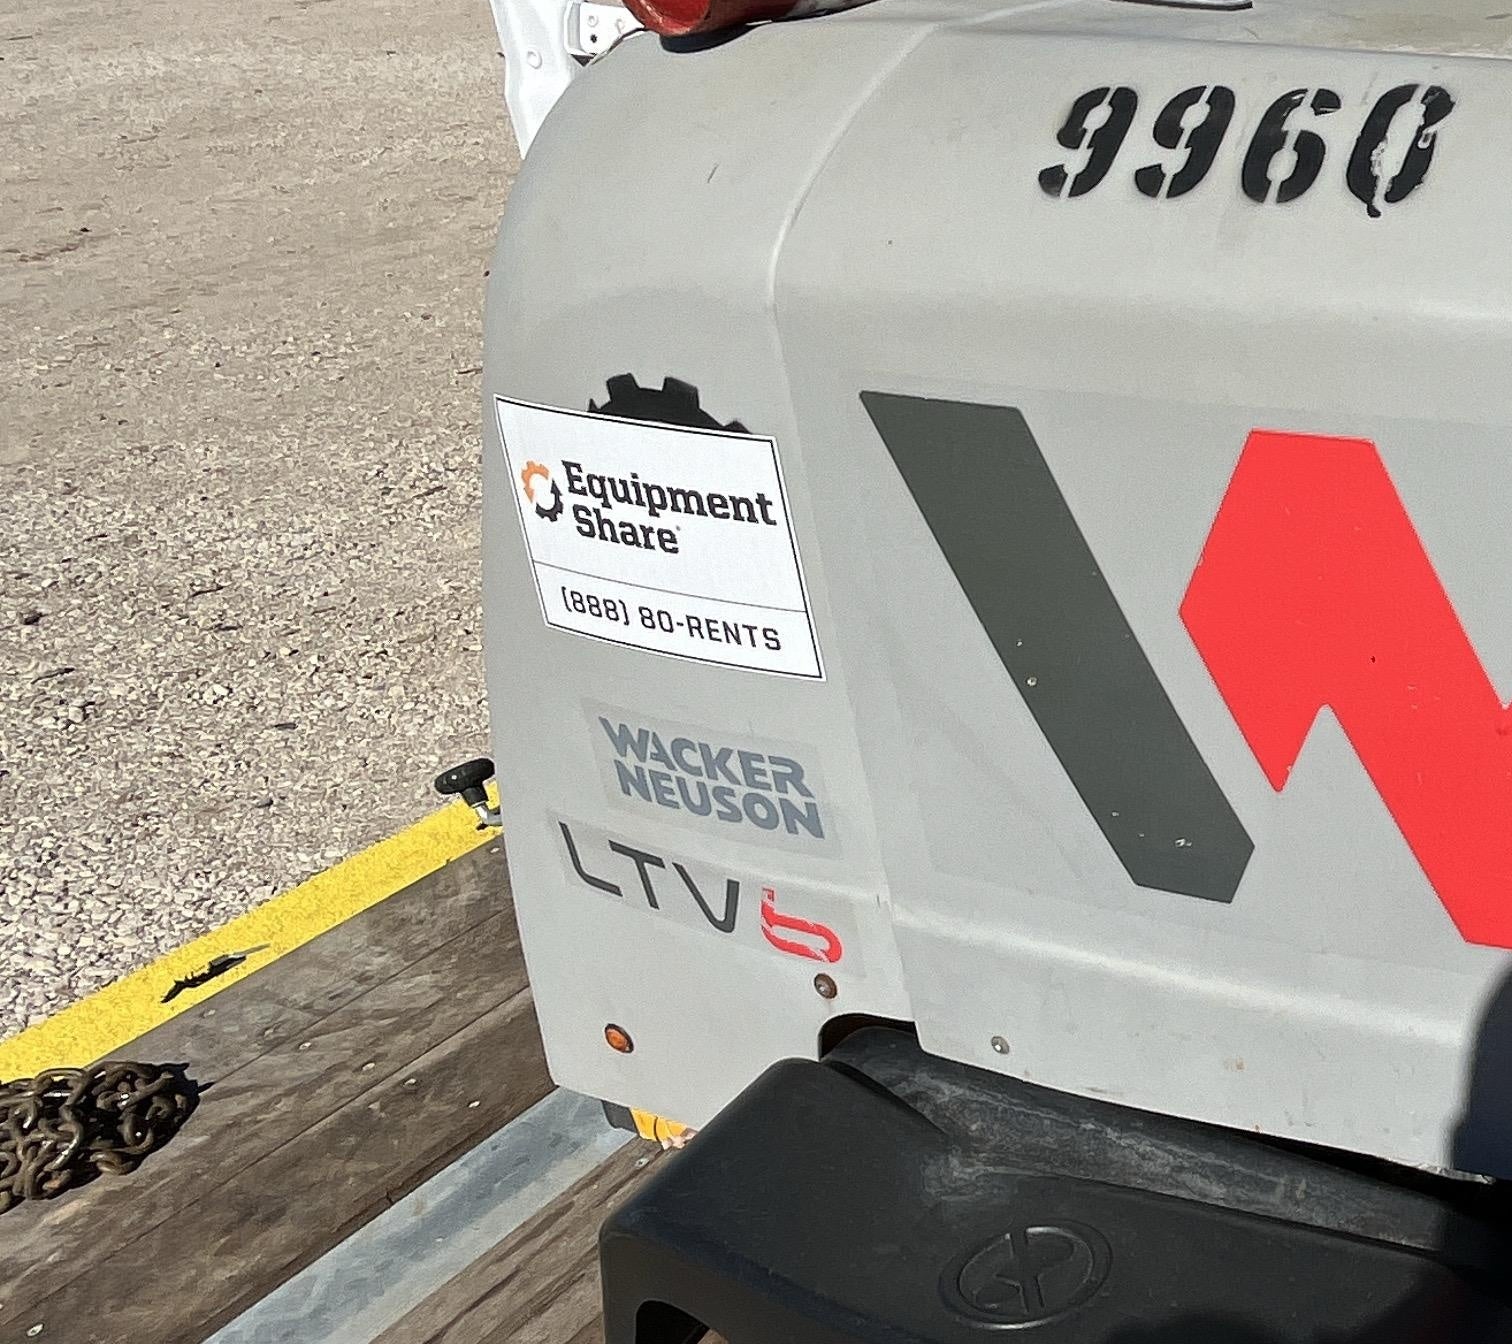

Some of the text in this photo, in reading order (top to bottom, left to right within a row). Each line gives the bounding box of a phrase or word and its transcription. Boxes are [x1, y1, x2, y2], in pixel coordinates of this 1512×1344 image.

[1037, 83, 1455, 218] 9960
[561, 459, 777, 526] Equipment
[572, 503, 681, 554] Share
[561, 586, 782, 651] (888) 80-RENTS
[600, 716, 815, 798] WACKER
[616, 759, 825, 839] NEUSON
